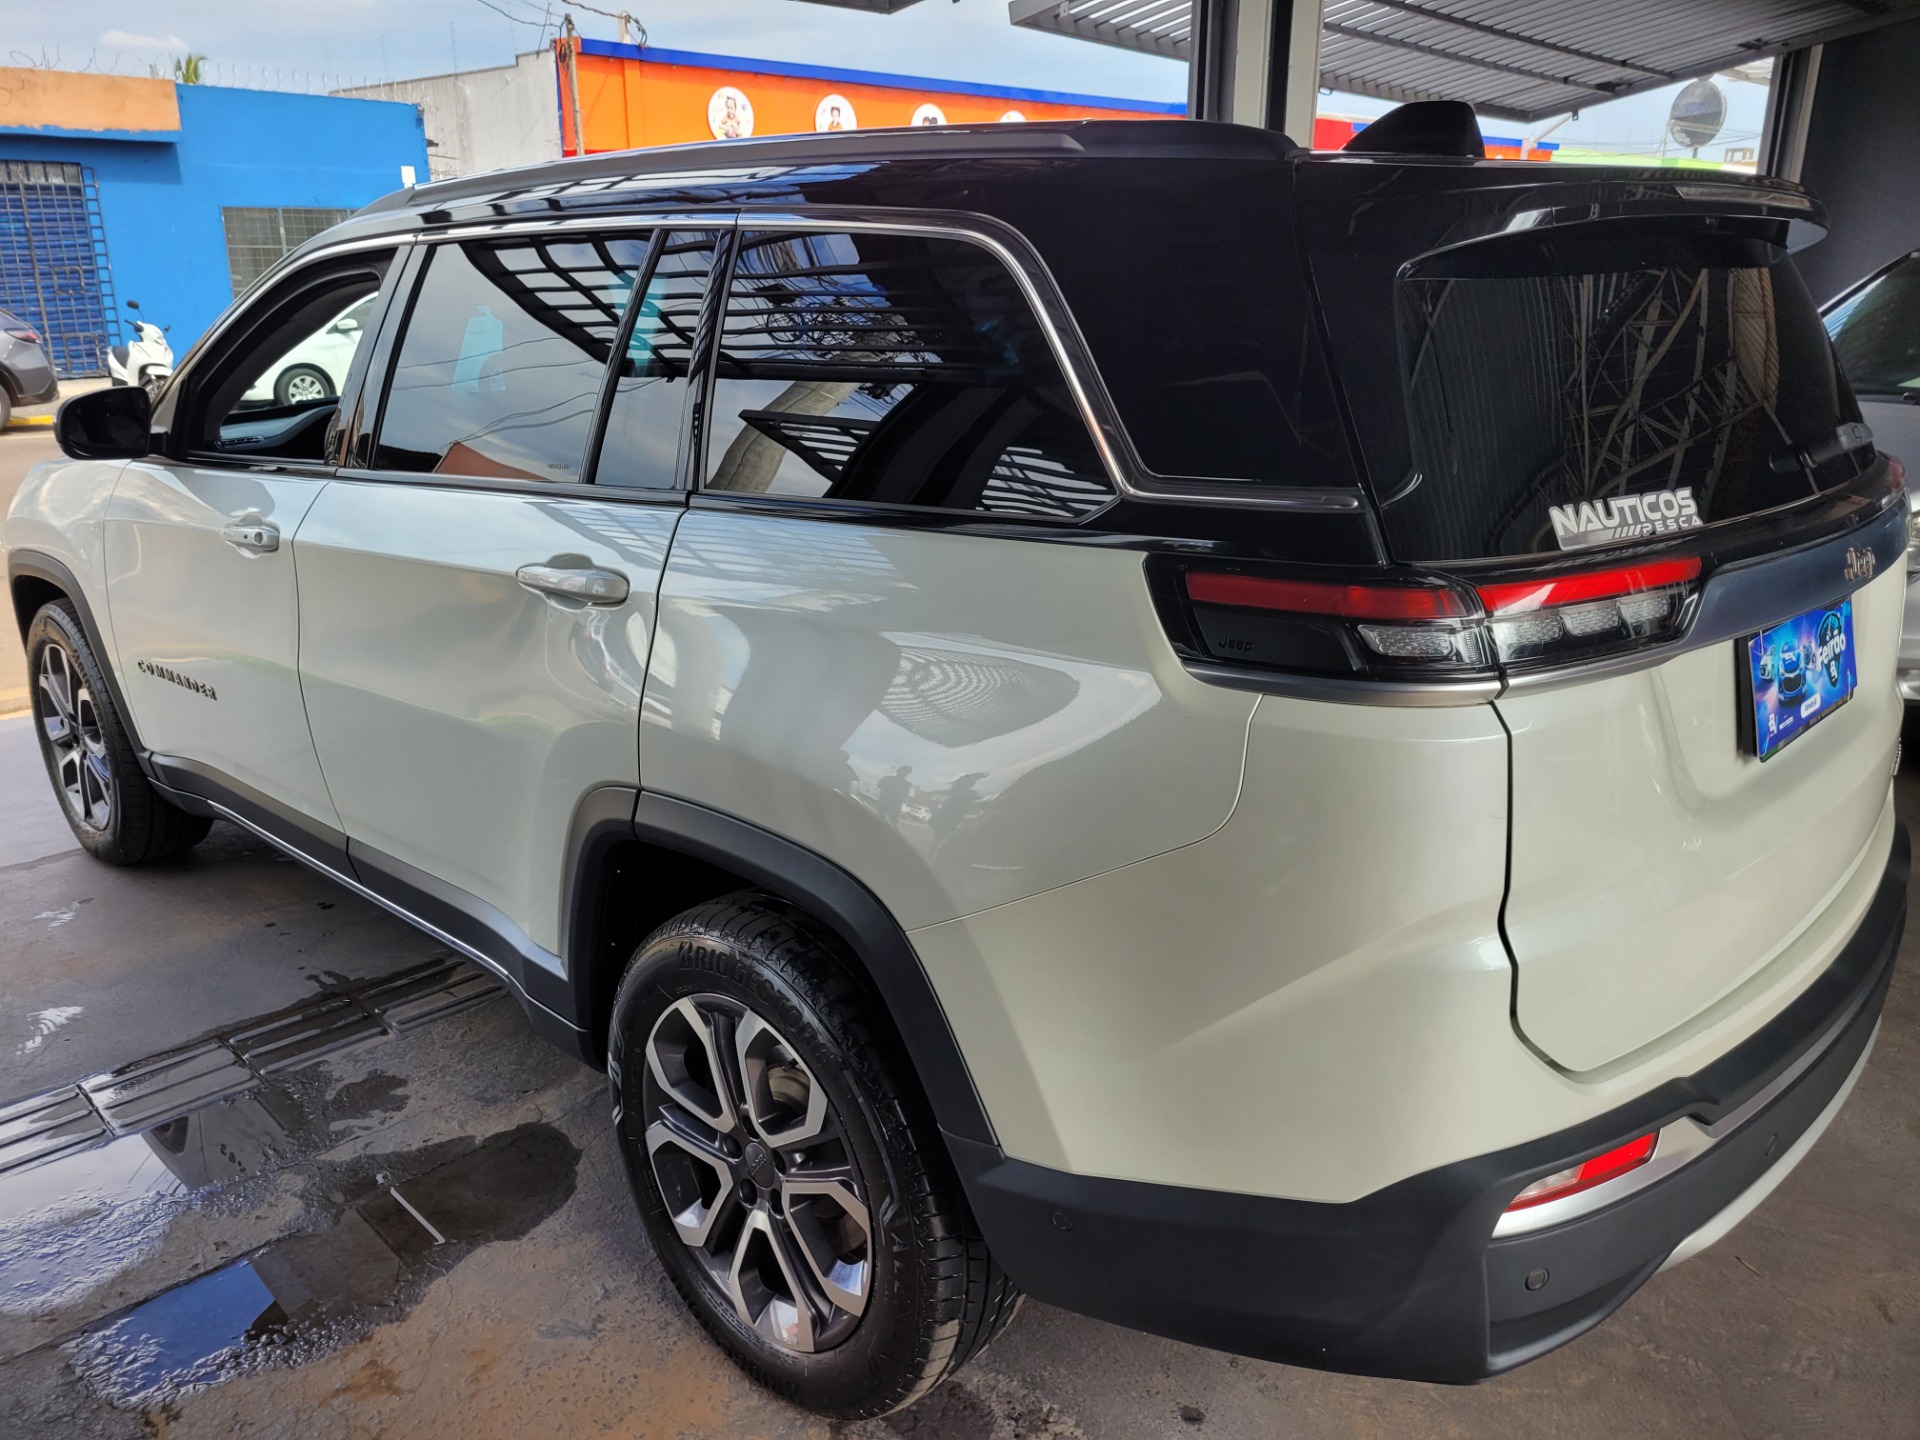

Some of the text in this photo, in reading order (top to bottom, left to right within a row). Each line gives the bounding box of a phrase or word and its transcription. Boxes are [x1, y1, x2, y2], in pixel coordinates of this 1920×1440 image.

[1549, 489, 1697, 537] NAUTICOS
[1641, 517, 1701, 535] PESCA
[1218, 634, 1253, 654] Jeep
[137, 659, 218, 701] COMMANDER
